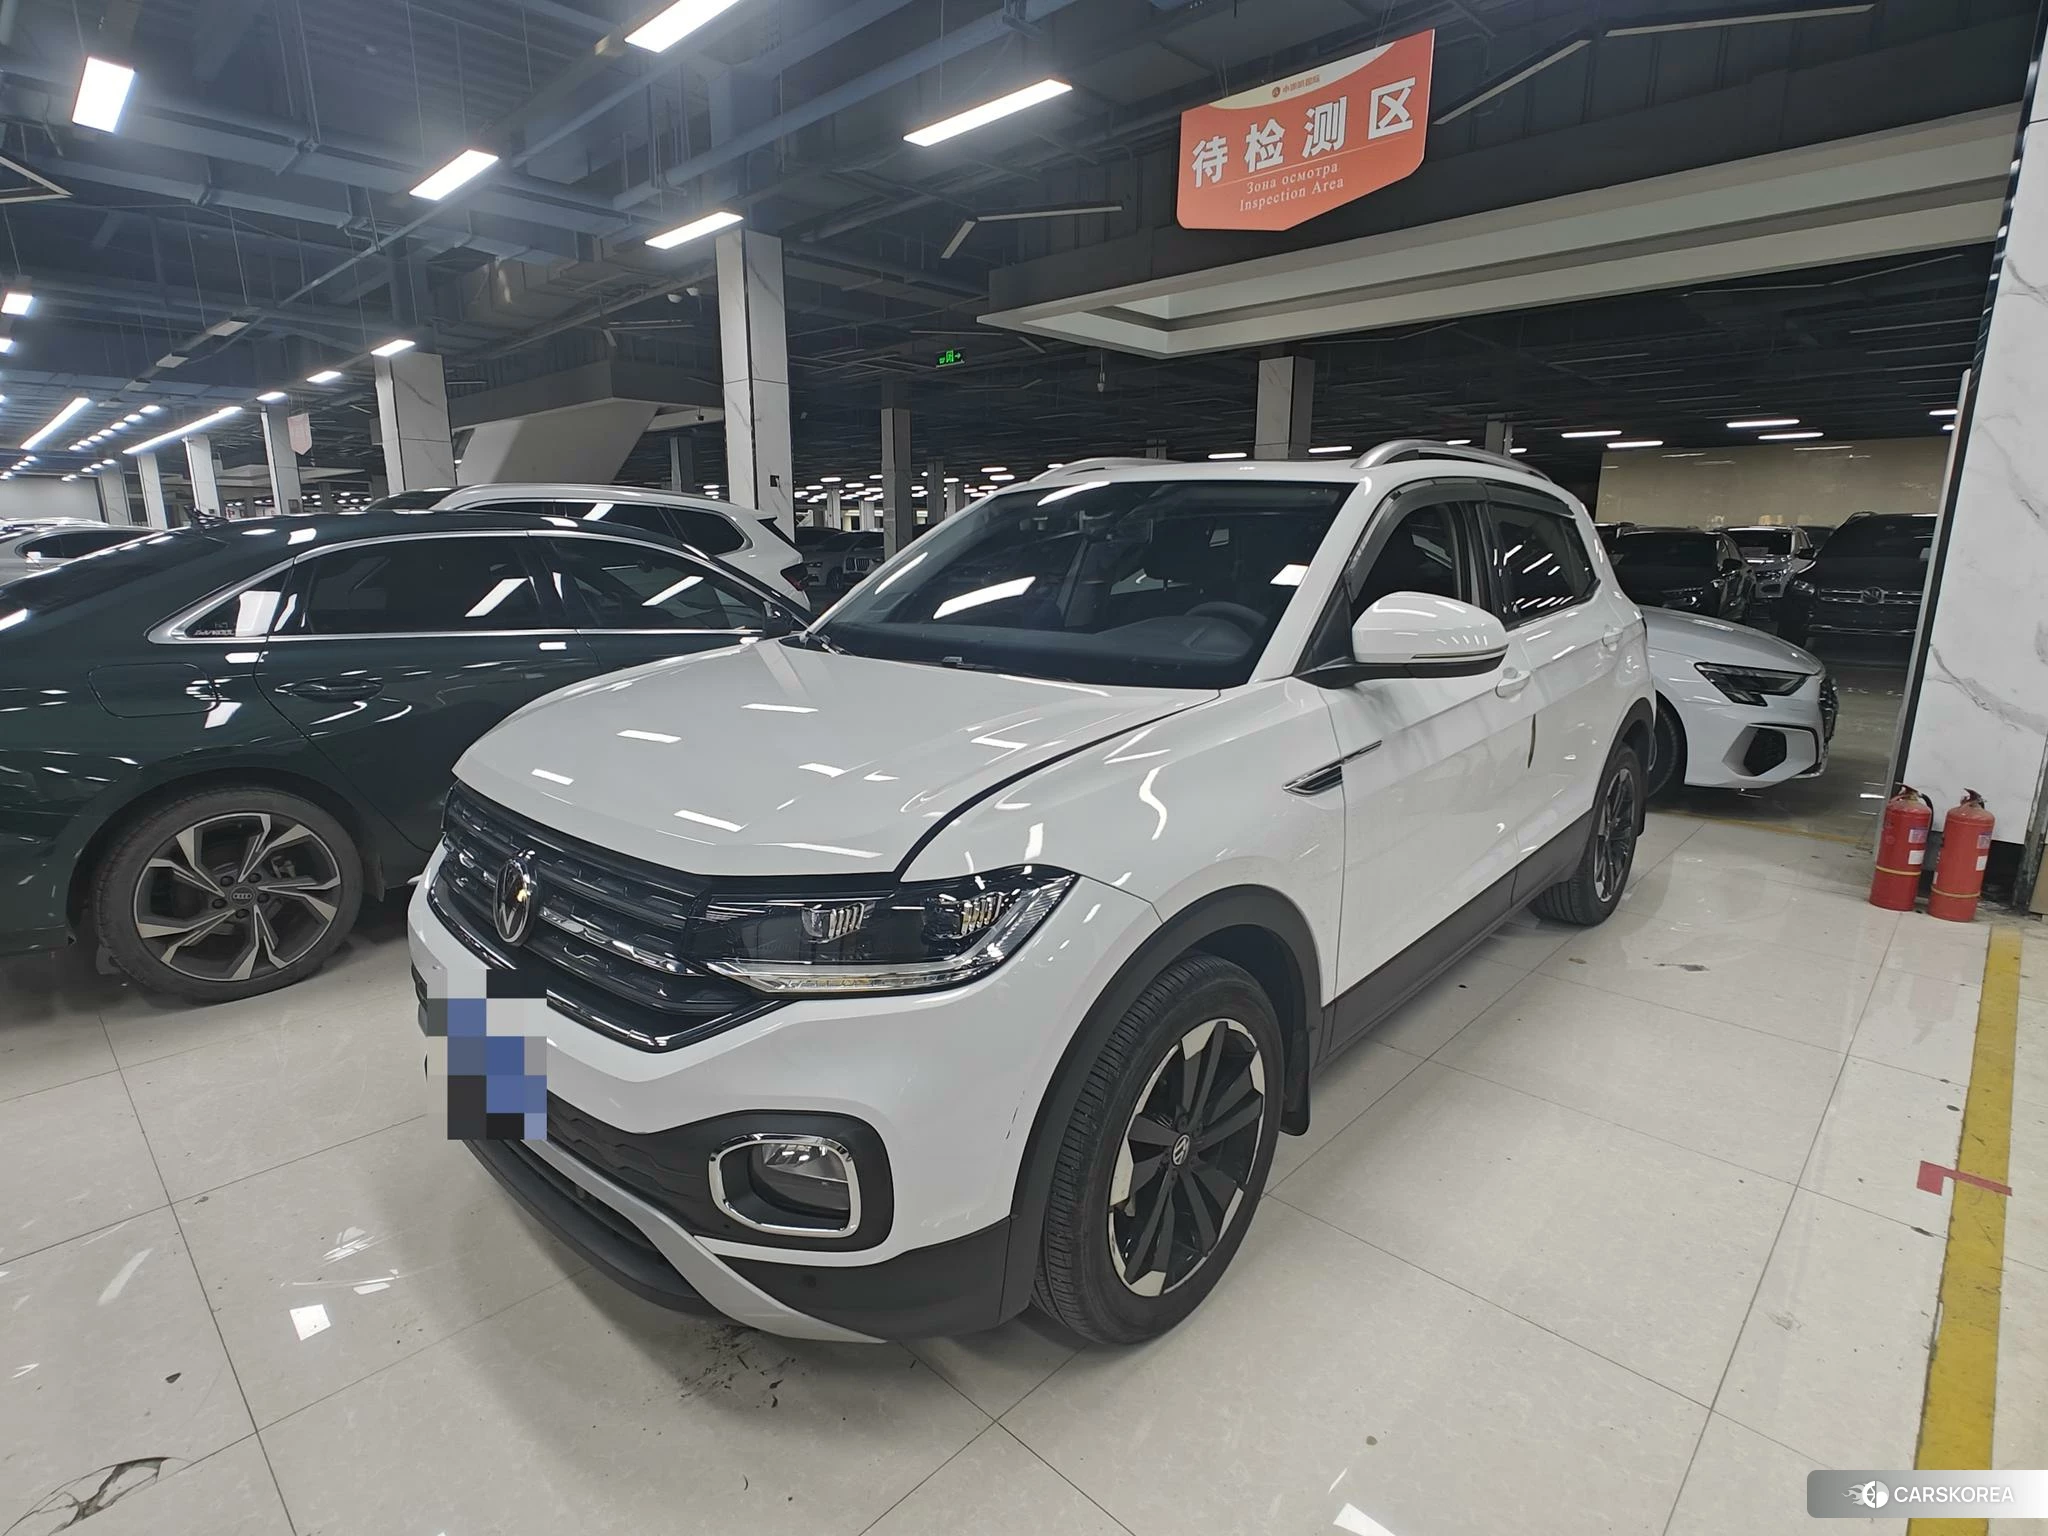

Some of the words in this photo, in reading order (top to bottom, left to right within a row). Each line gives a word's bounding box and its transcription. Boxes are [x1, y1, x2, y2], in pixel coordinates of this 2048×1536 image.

[1191, 77, 1416, 187] 待检测区
[1240, 187, 1306, 211] Inspection
[1312, 178, 1344, 195] Area
[1247, 179, 1276, 194] Зона
[1282, 163, 1338, 184] осмотра
